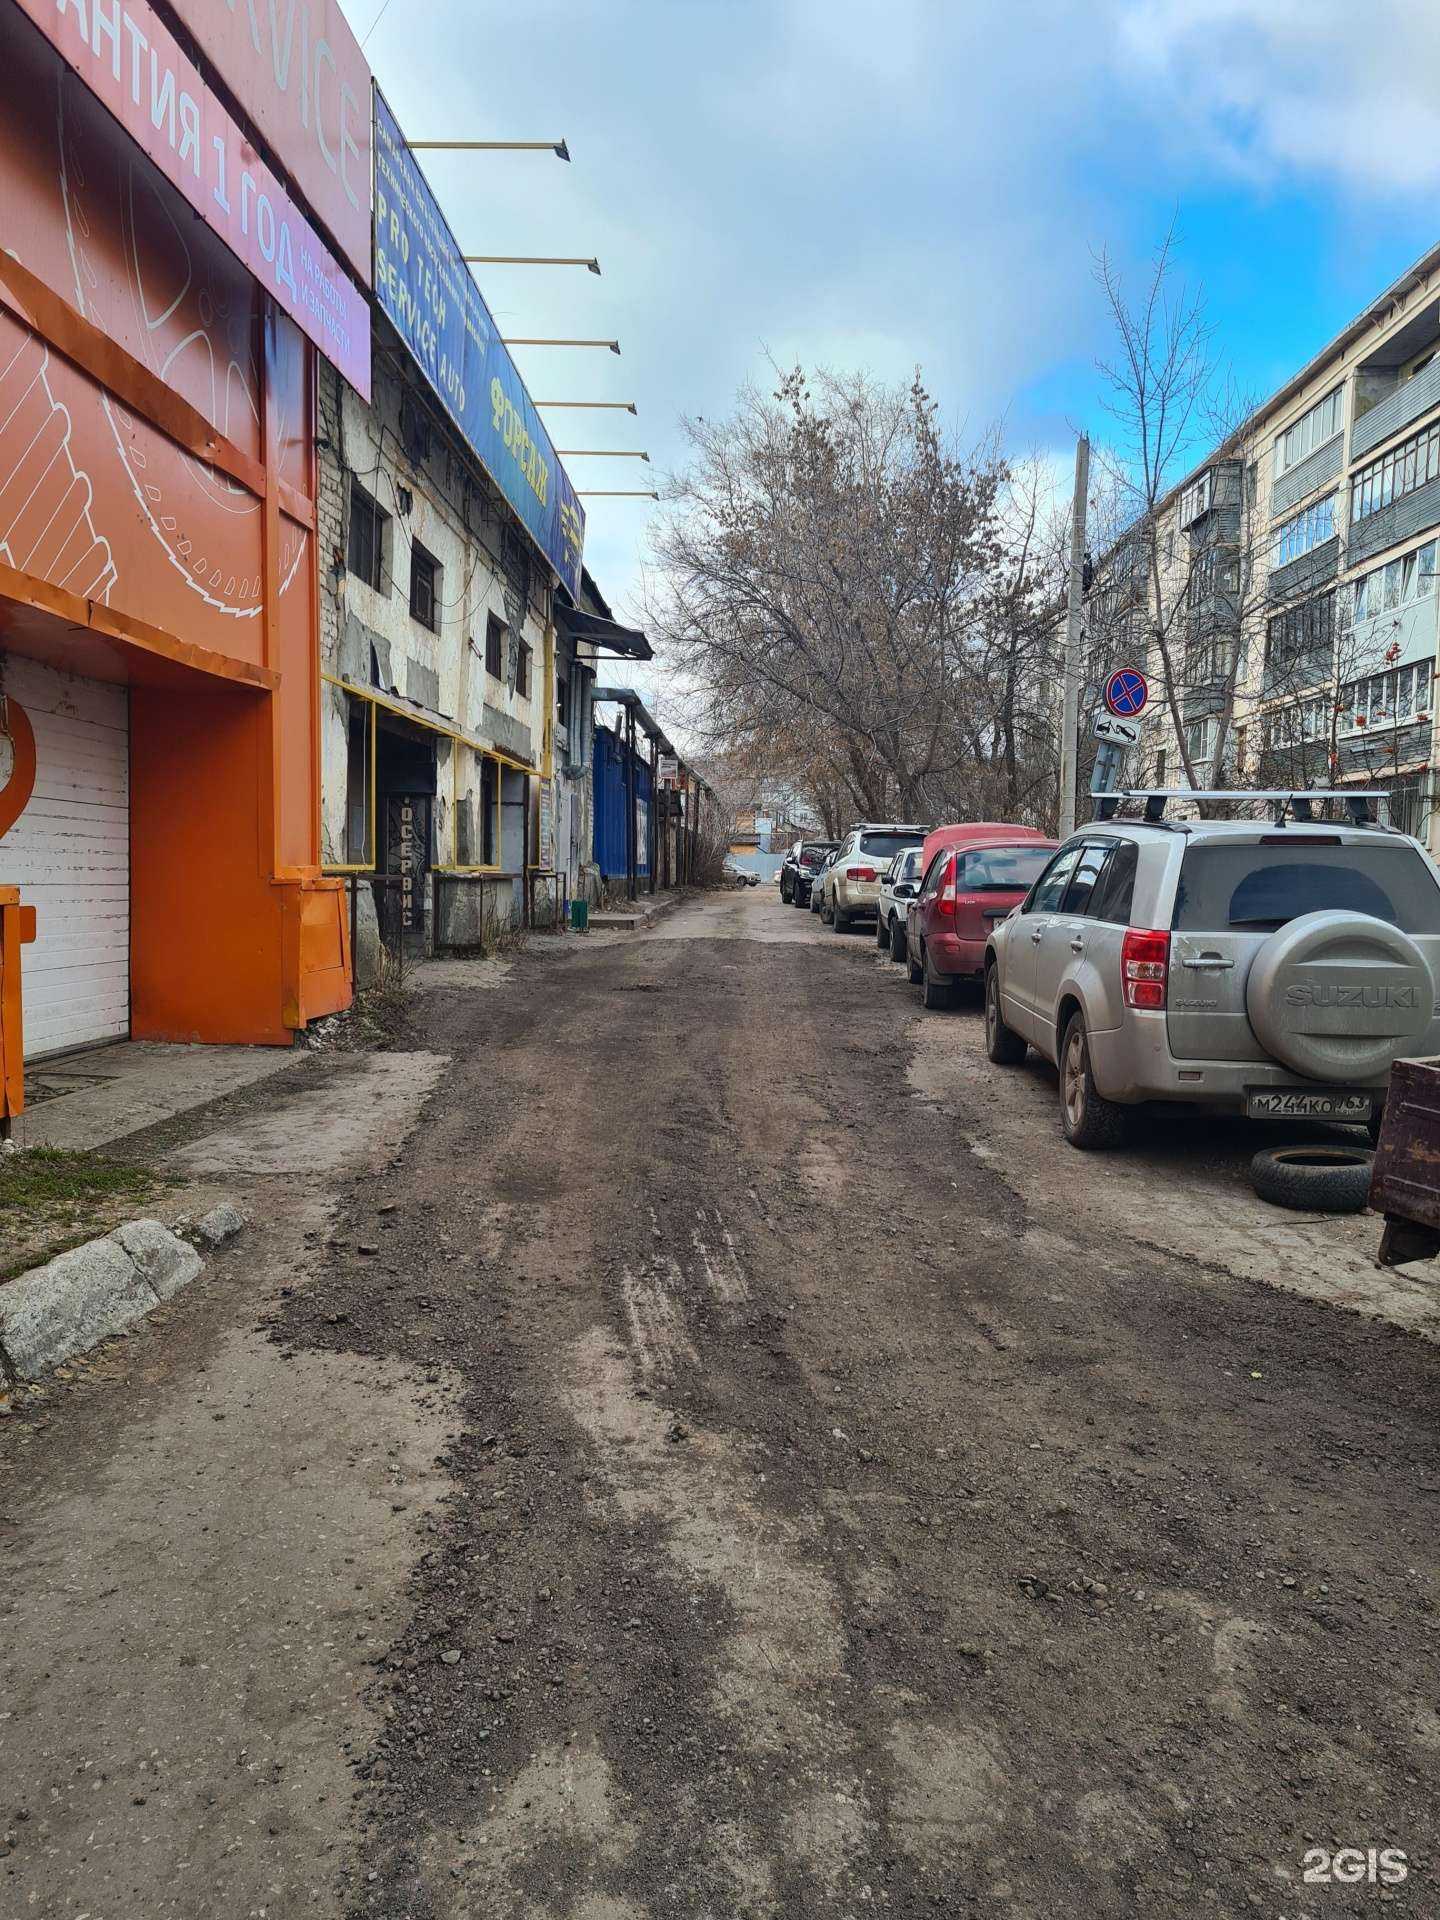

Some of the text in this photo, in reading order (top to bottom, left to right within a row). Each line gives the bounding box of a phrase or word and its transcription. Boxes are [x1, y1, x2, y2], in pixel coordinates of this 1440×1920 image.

[212, 136, 230, 215] 1
[241, 171, 298, 304] ГОД
[300, 244, 314, 279] НА
[377, 190, 447, 330] PRO TECH
[377, 247, 466, 412] SERVICE AUTO
[491, 376, 548, 508] ФОРСАЖ
[401, 798, 412, 925] ОСЕРВИС
[1286, 984, 1421, 1008] SUZUKI
